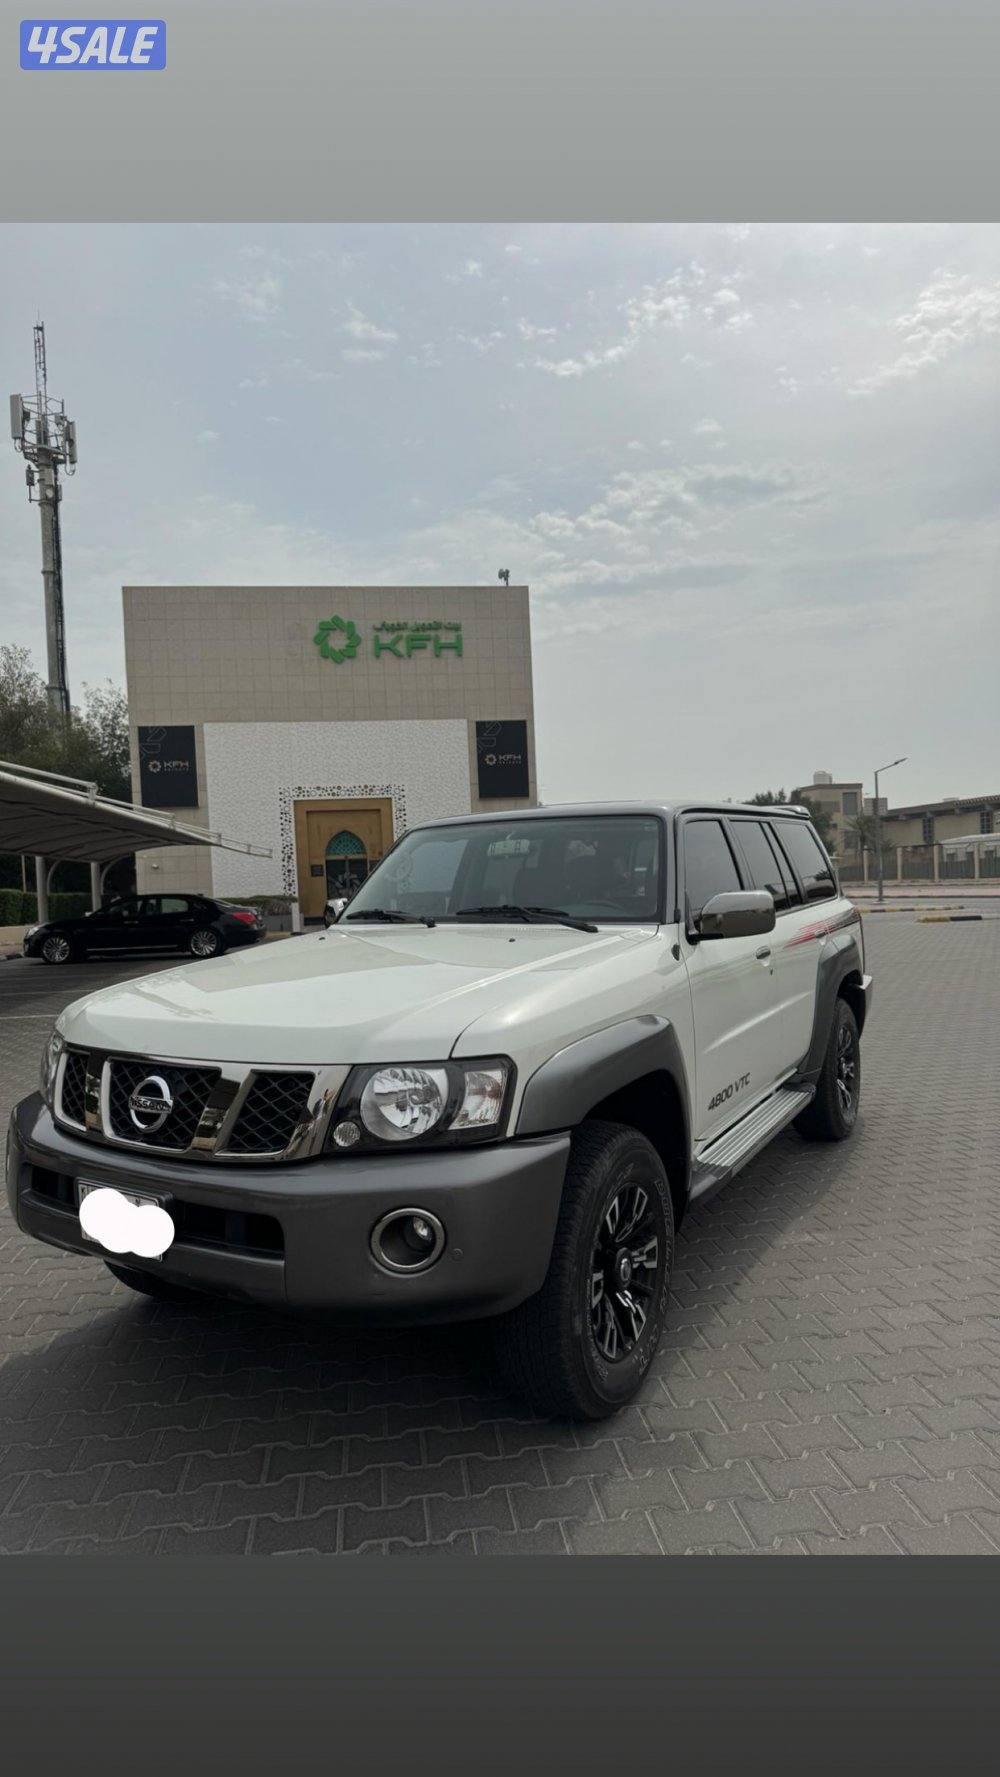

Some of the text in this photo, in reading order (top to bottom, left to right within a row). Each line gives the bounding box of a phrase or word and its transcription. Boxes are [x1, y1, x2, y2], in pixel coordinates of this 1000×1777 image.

[374, 634, 463, 658] KFH
[164, 761, 189, 769] KFH
[708, 1072, 750, 1111] 4800 VTC
